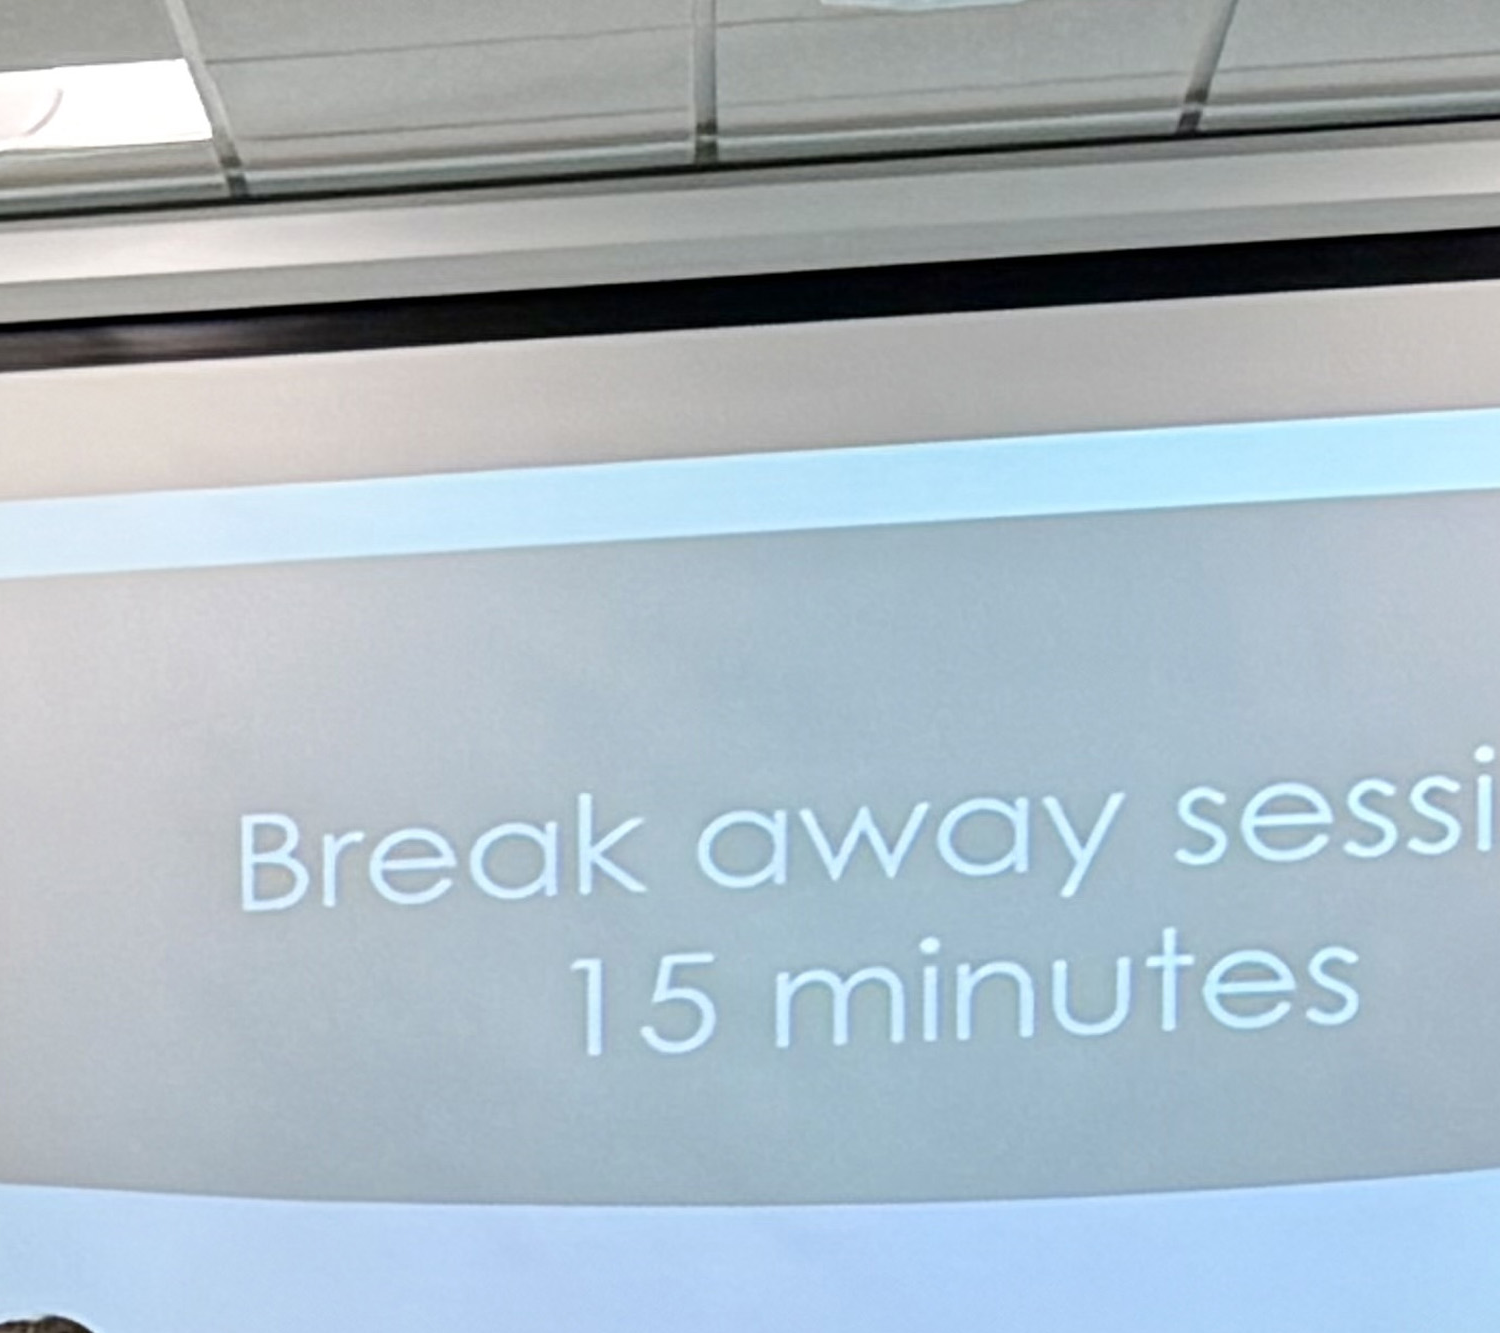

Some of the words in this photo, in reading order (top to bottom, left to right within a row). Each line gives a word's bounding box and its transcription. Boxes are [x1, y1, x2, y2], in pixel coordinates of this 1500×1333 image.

[239, 791, 649, 913] Break
[695, 790, 1128, 900] away
[1173, 743, 1497, 867] sessi
[569, 951, 719, 1058] 15
[774, 925, 1361, 1050] minutes
